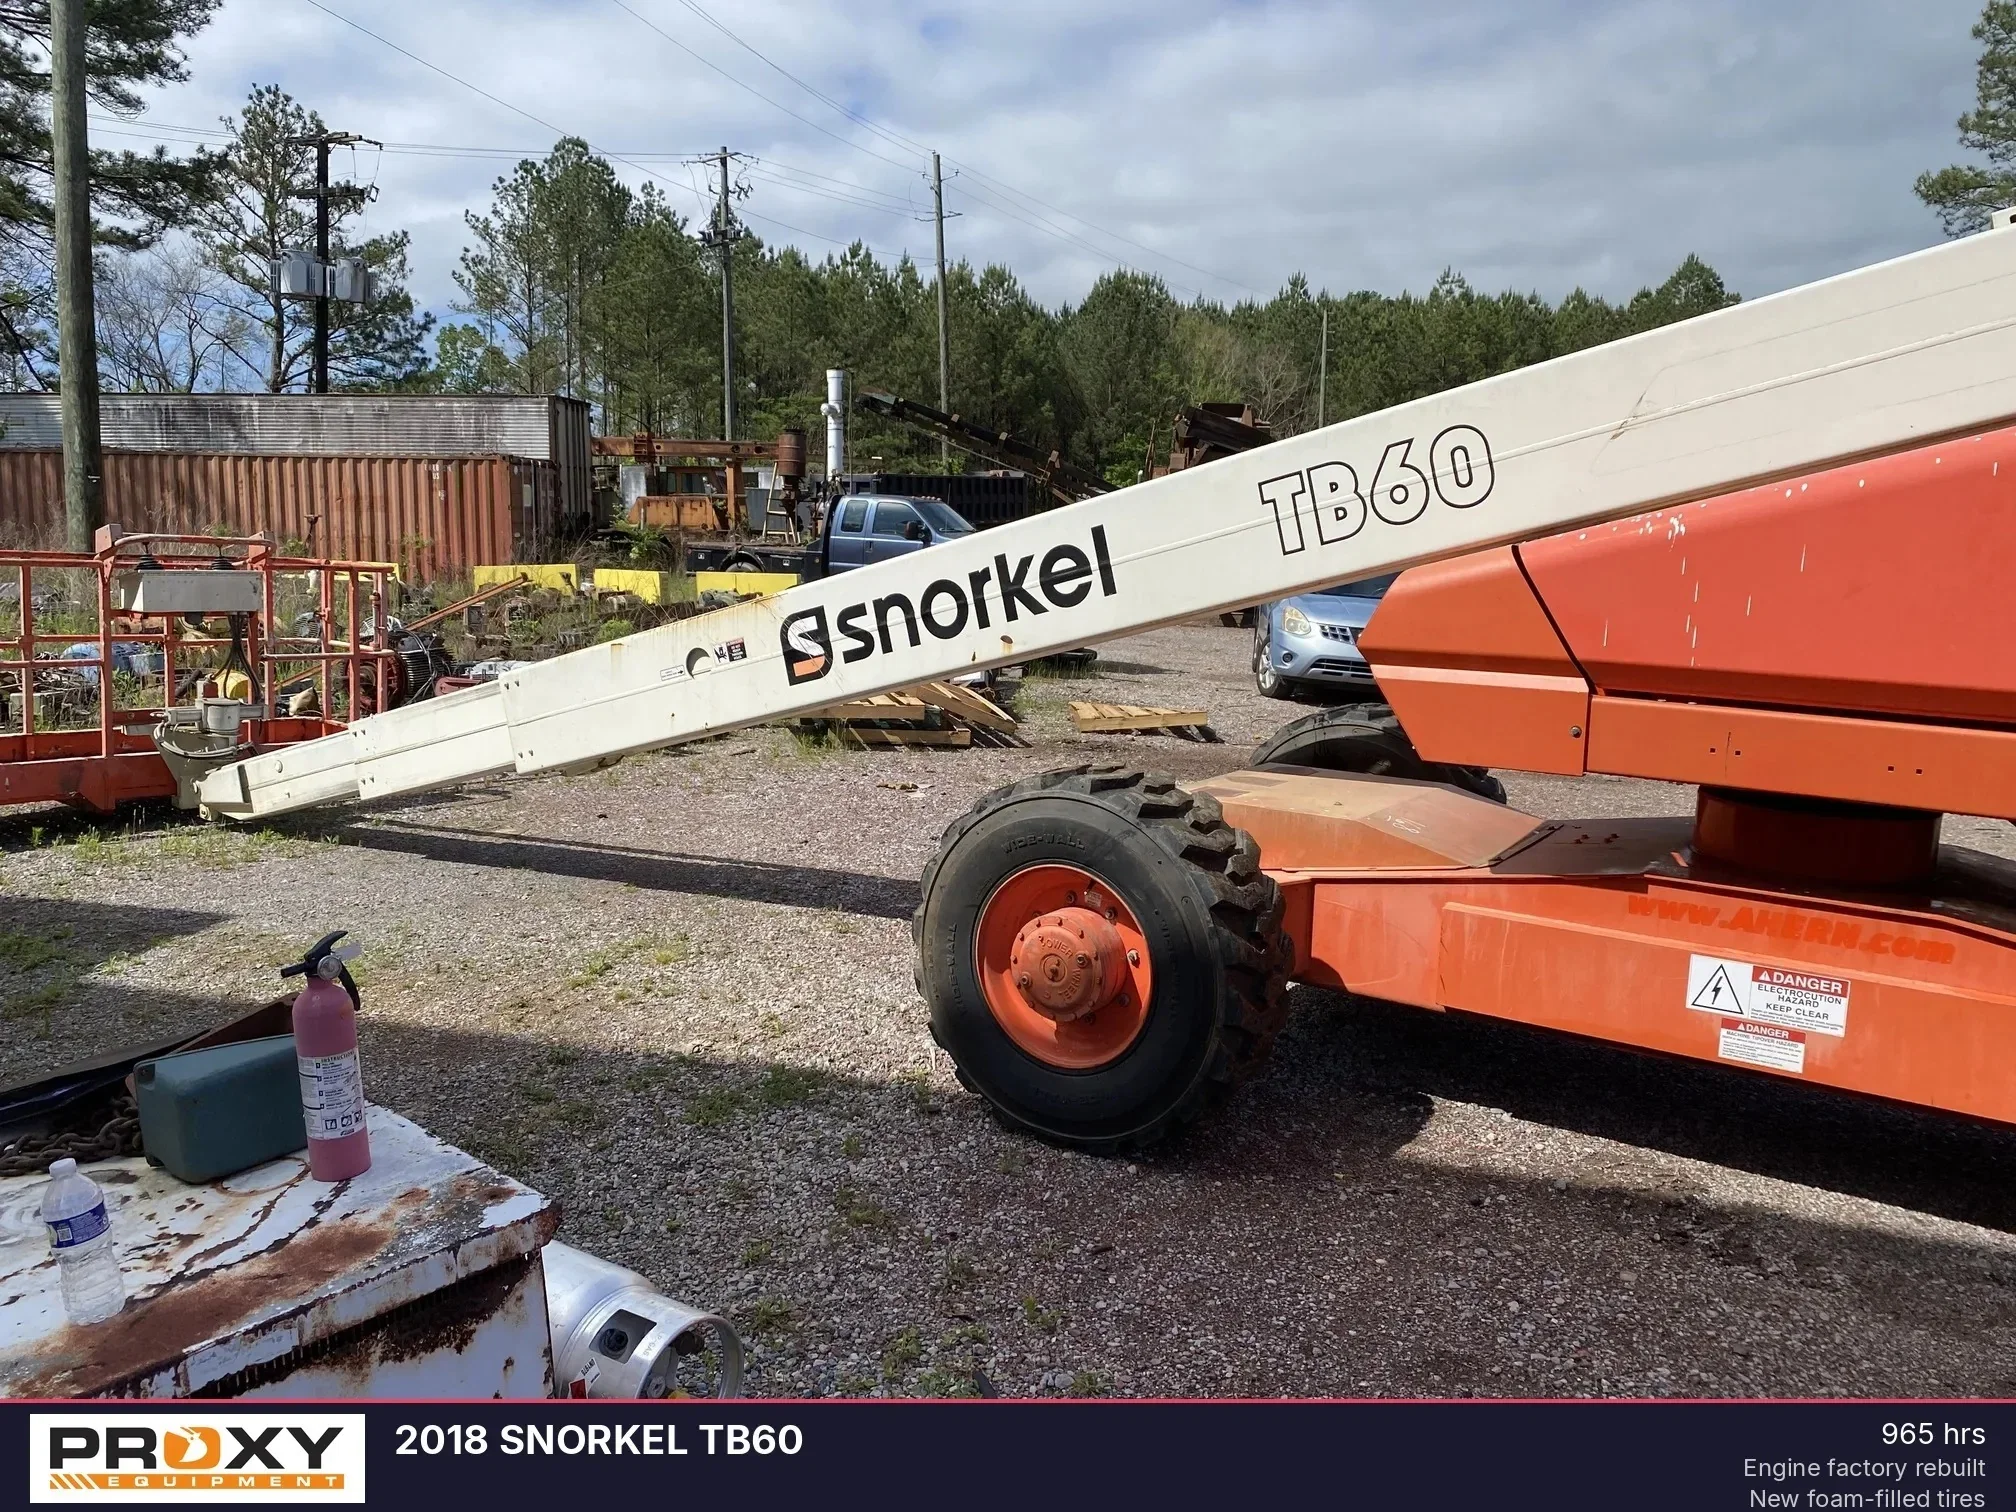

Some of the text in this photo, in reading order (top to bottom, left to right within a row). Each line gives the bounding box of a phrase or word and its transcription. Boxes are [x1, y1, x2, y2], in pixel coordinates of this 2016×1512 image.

[1259, 424, 1496, 556] TB60
[836, 523, 1117, 666] snorkel
[1627, 895, 1956, 965] www.AHERN.com
[1757, 983, 1842, 1005] ELECTROCUTION
[1773, 971, 1843, 995] DANGER
[1766, 1003, 1793, 1013] KEEP
[1795, 1008, 1829, 1021] CLEAR
[1777, 994, 1820, 1008] HAZARD
[1746, 1023, 1790, 1039] DANGER
[1776, 1039, 1799, 1049] HAZARD
